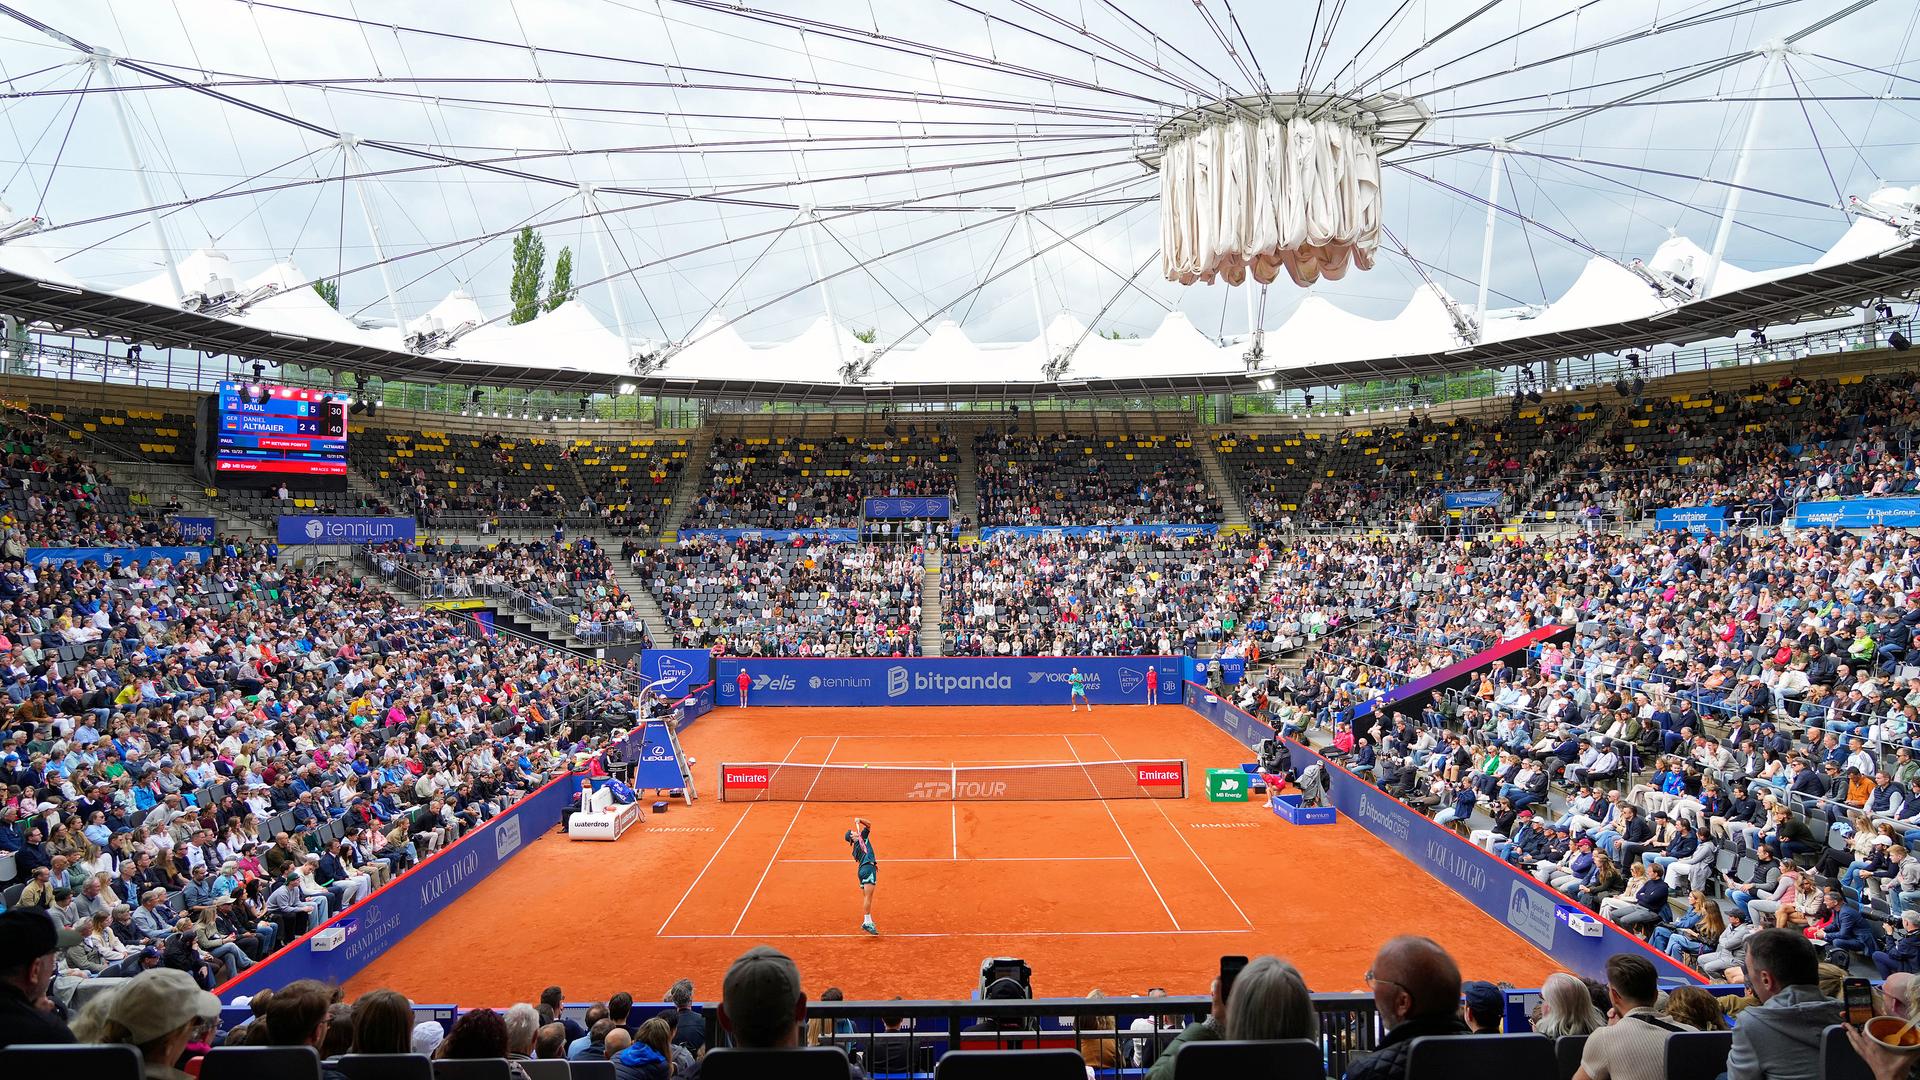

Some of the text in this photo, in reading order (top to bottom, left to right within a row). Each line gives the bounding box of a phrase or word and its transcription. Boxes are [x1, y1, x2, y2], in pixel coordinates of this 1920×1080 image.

[243, 423, 284, 432] ALTMAIER
[184, 523, 212, 536] Helios
[326, 521, 394, 536] tennium
[770, 674, 796, 690] elis
[823, 675, 871, 688] tennium
[915, 672, 1012, 694] bitpanda
[726, 774, 766, 782] Emirates
[1139, 771, 1179, 780] Emirates
[908, 781, 1007, 798] ATP TOUR
[1366, 802, 1393, 830] bitpanda
[1393, 821, 1409, 840] OPEN
[1426, 840, 1486, 892] ACQUA DI GIÒ
[420, 850, 478, 908] ACQUA DI GIÒ
[346, 933, 373, 960] GRAND
